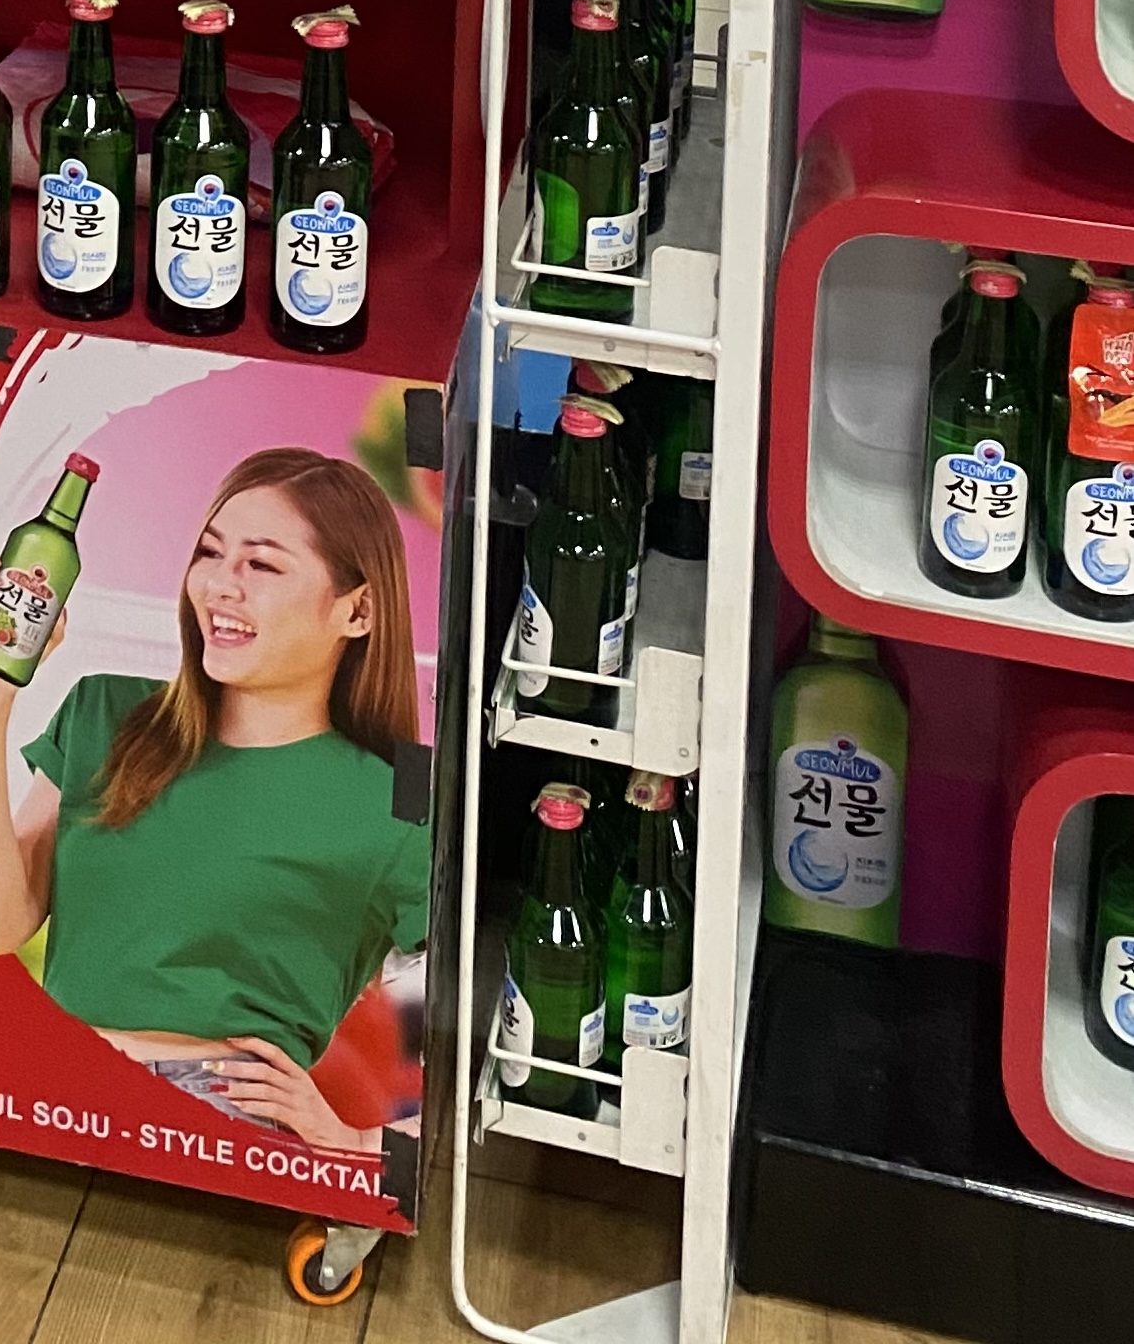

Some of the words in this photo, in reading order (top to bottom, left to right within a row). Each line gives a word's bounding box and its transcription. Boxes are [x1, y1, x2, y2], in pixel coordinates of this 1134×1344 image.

[174, 200, 231, 215] SEONMUL
[295, 216, 352, 232] SEONMUL
[952, 459, 1013, 481] SEONMUL
[801, 754, 875, 780] SEONMUL
[32, 1101, 110, 1140] SOJU
[139, 1123, 235, 1166] STYLE
[244, 1145, 398, 1200] COCKTAI
